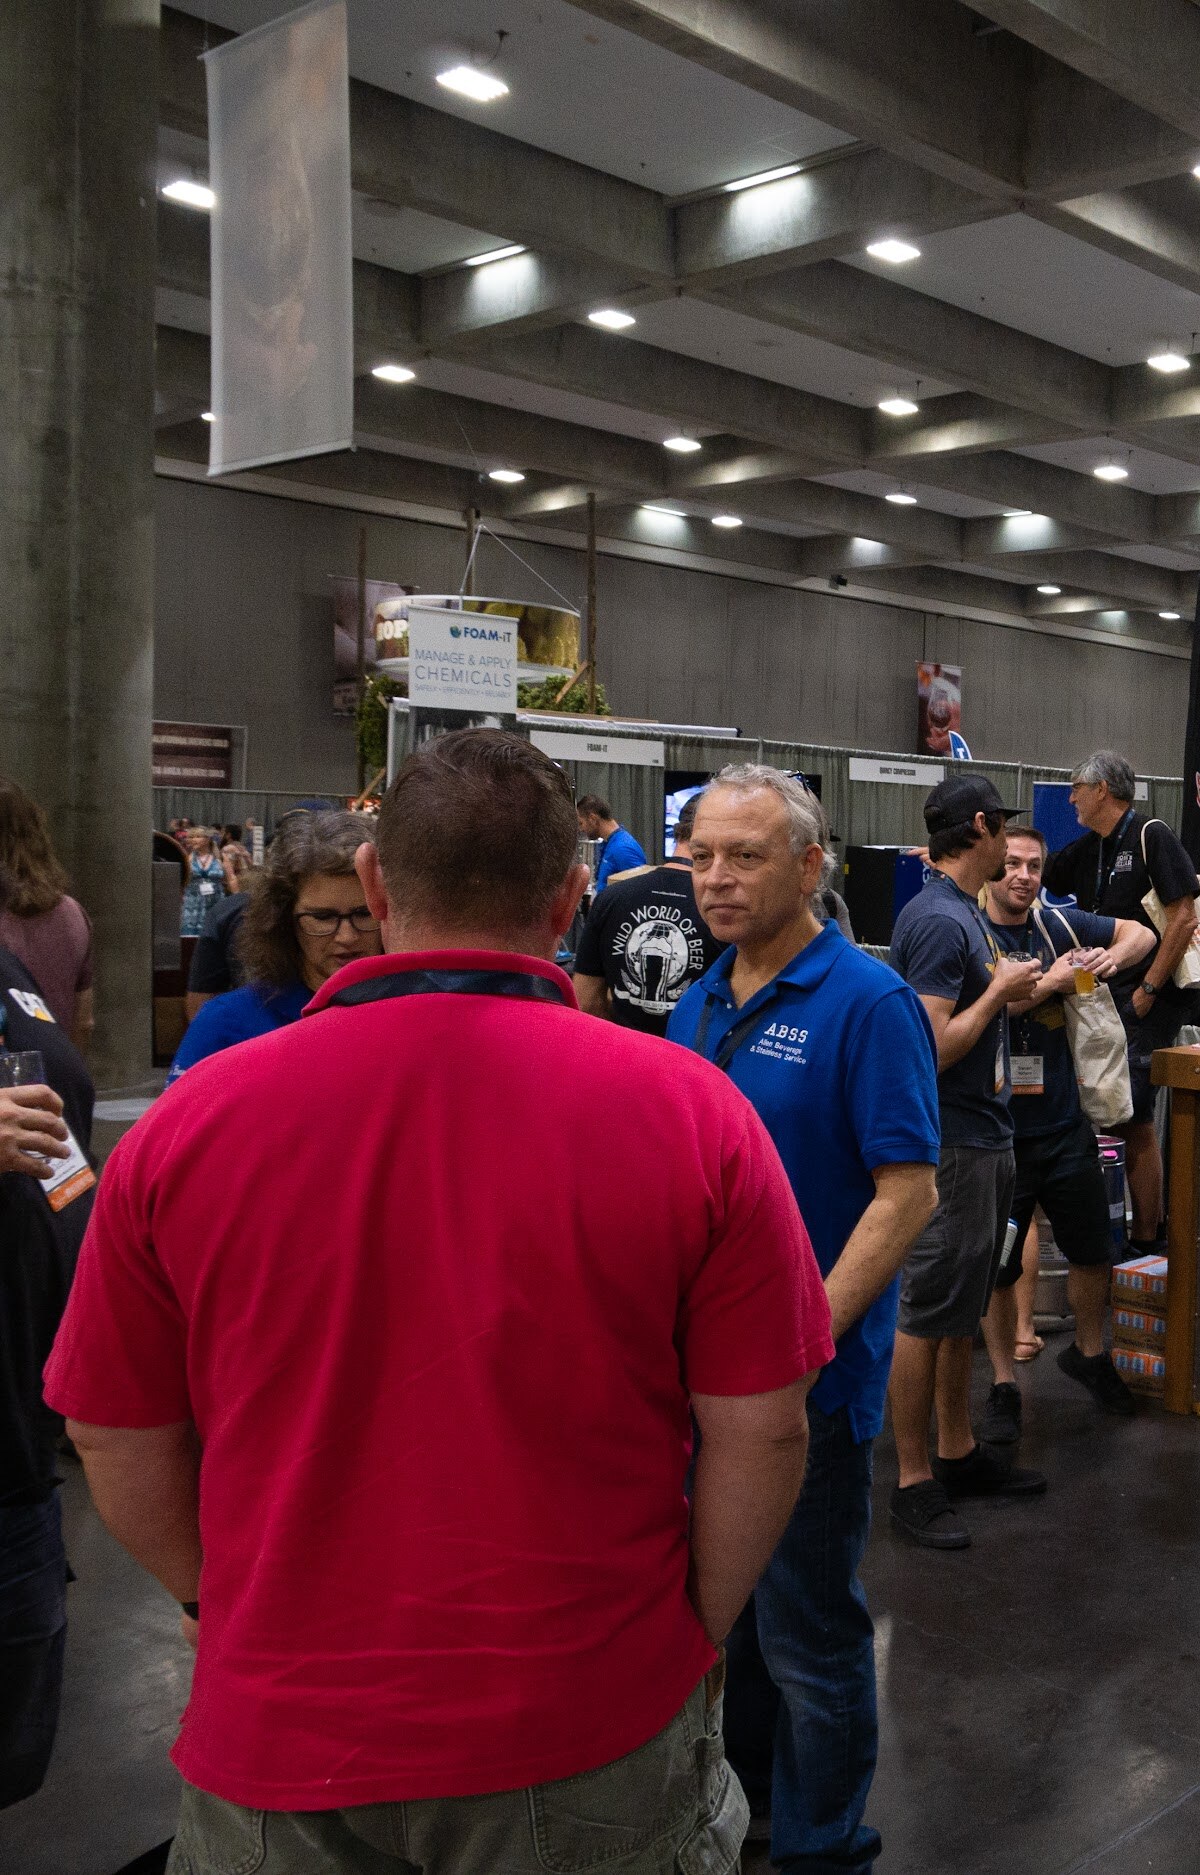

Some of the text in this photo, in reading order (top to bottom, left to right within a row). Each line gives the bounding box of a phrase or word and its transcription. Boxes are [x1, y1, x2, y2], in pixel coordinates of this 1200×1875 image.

[414, 649, 513, 669] MANAGE & APPLY
[414, 665, 512, 688] CHEMICALS
[612, 905, 704, 971] WILD WORLD OF BEER
[763, 1022, 809, 1044] ABSS
[749, 1045, 807, 1065] & Stainless Service
[758, 1038, 802, 1055] Allen Beverage
